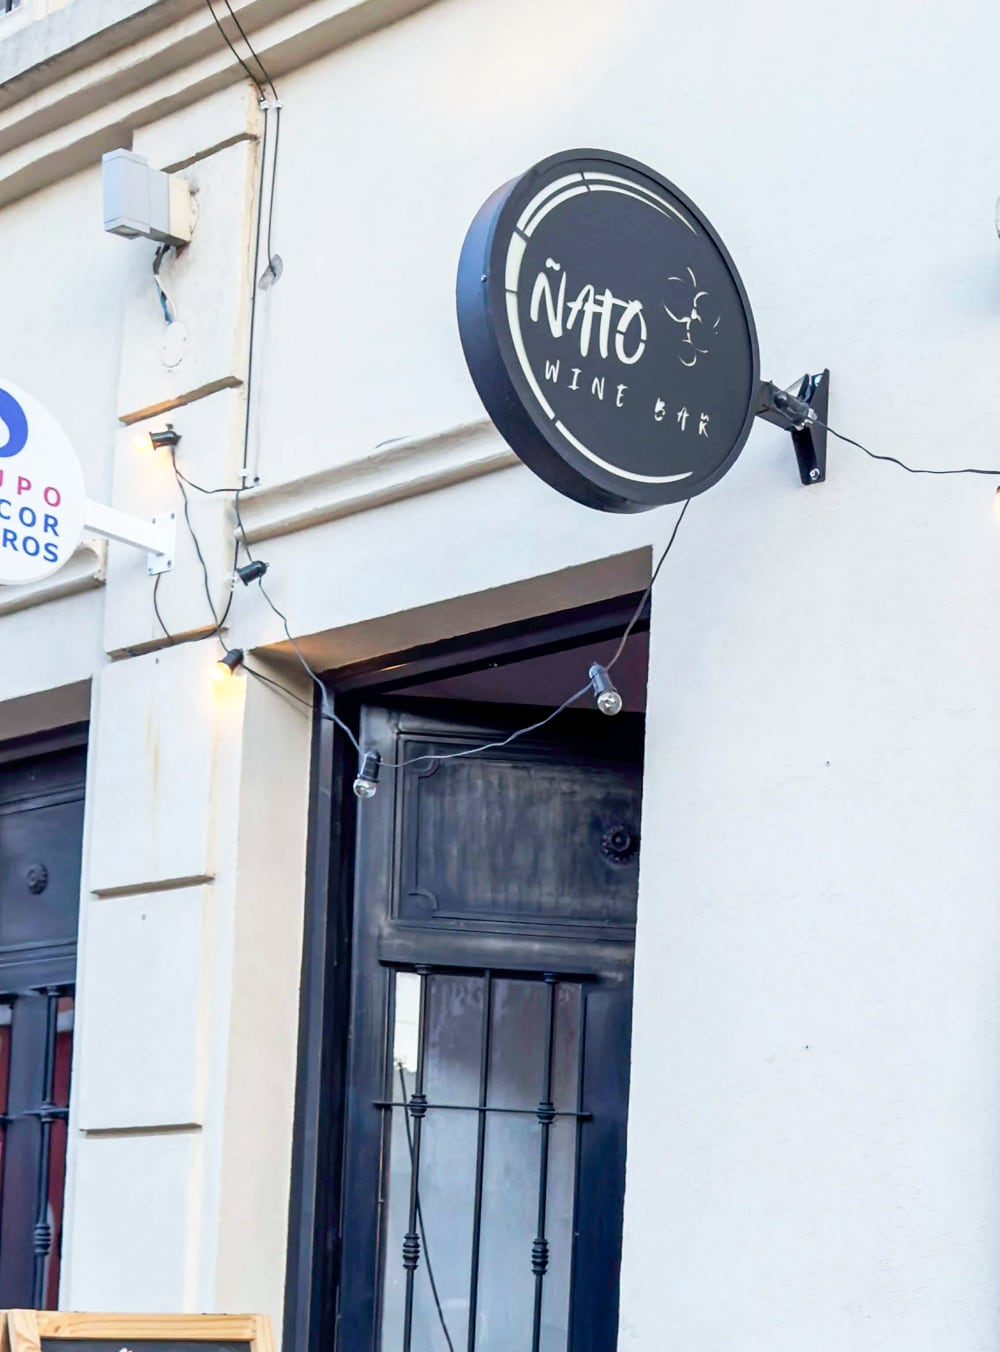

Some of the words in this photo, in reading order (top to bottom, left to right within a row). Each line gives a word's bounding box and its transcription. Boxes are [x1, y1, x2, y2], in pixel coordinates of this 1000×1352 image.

[530, 257, 647, 364] ÑATO
[545, 359, 629, 407] WINE
[654, 397, 710, 438] BAR
